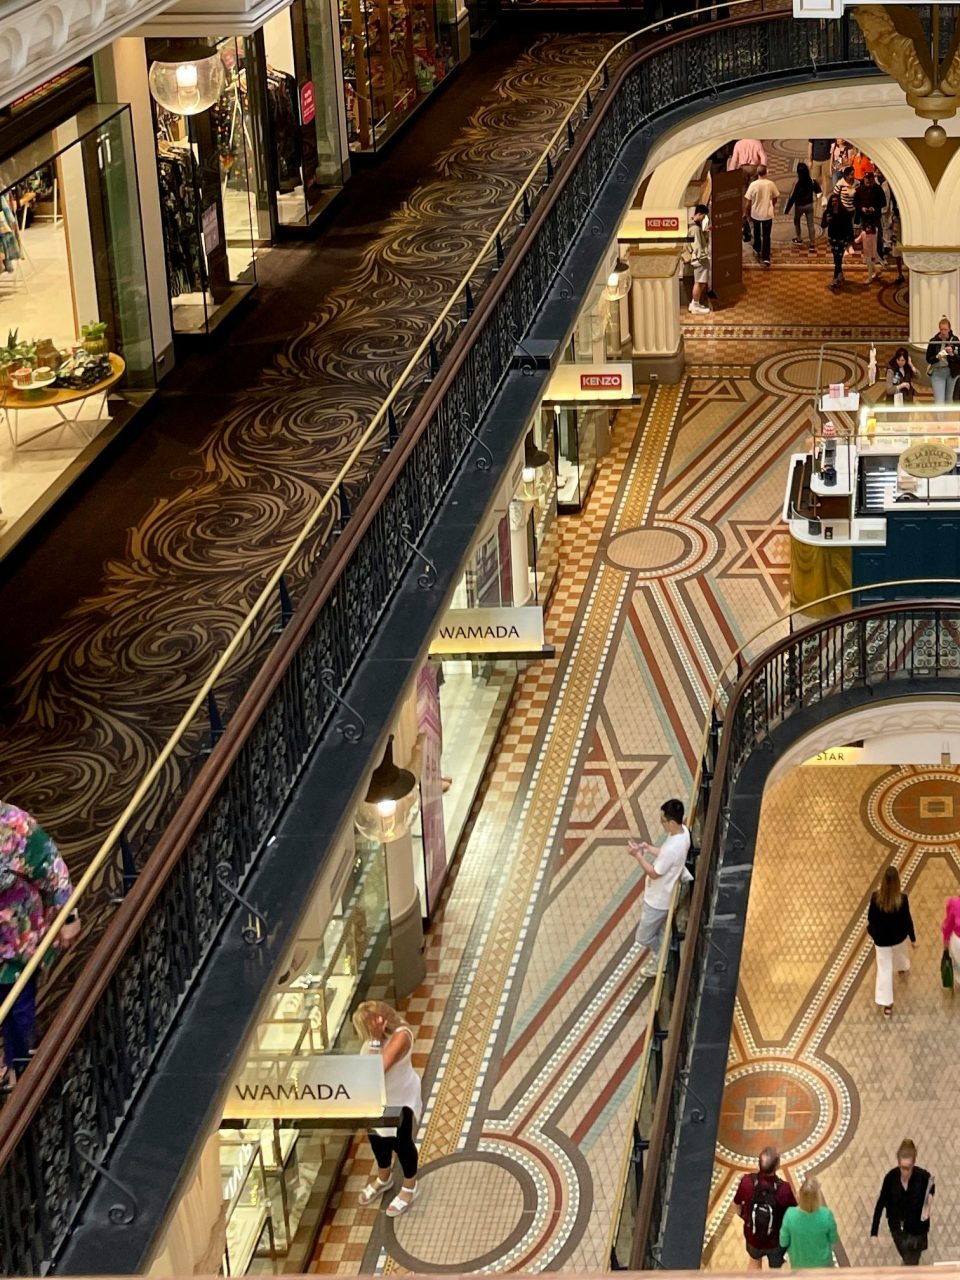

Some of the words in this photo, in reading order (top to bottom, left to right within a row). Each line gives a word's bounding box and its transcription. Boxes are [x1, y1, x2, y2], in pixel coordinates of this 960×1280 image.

[646, 219, 678, 228] KENZO
[582, 375, 621, 386] KENZO
[439, 625, 520, 639] WAMADA
[816, 752, 844, 761] STAR
[235, 1084, 351, 1101] WAMADA
